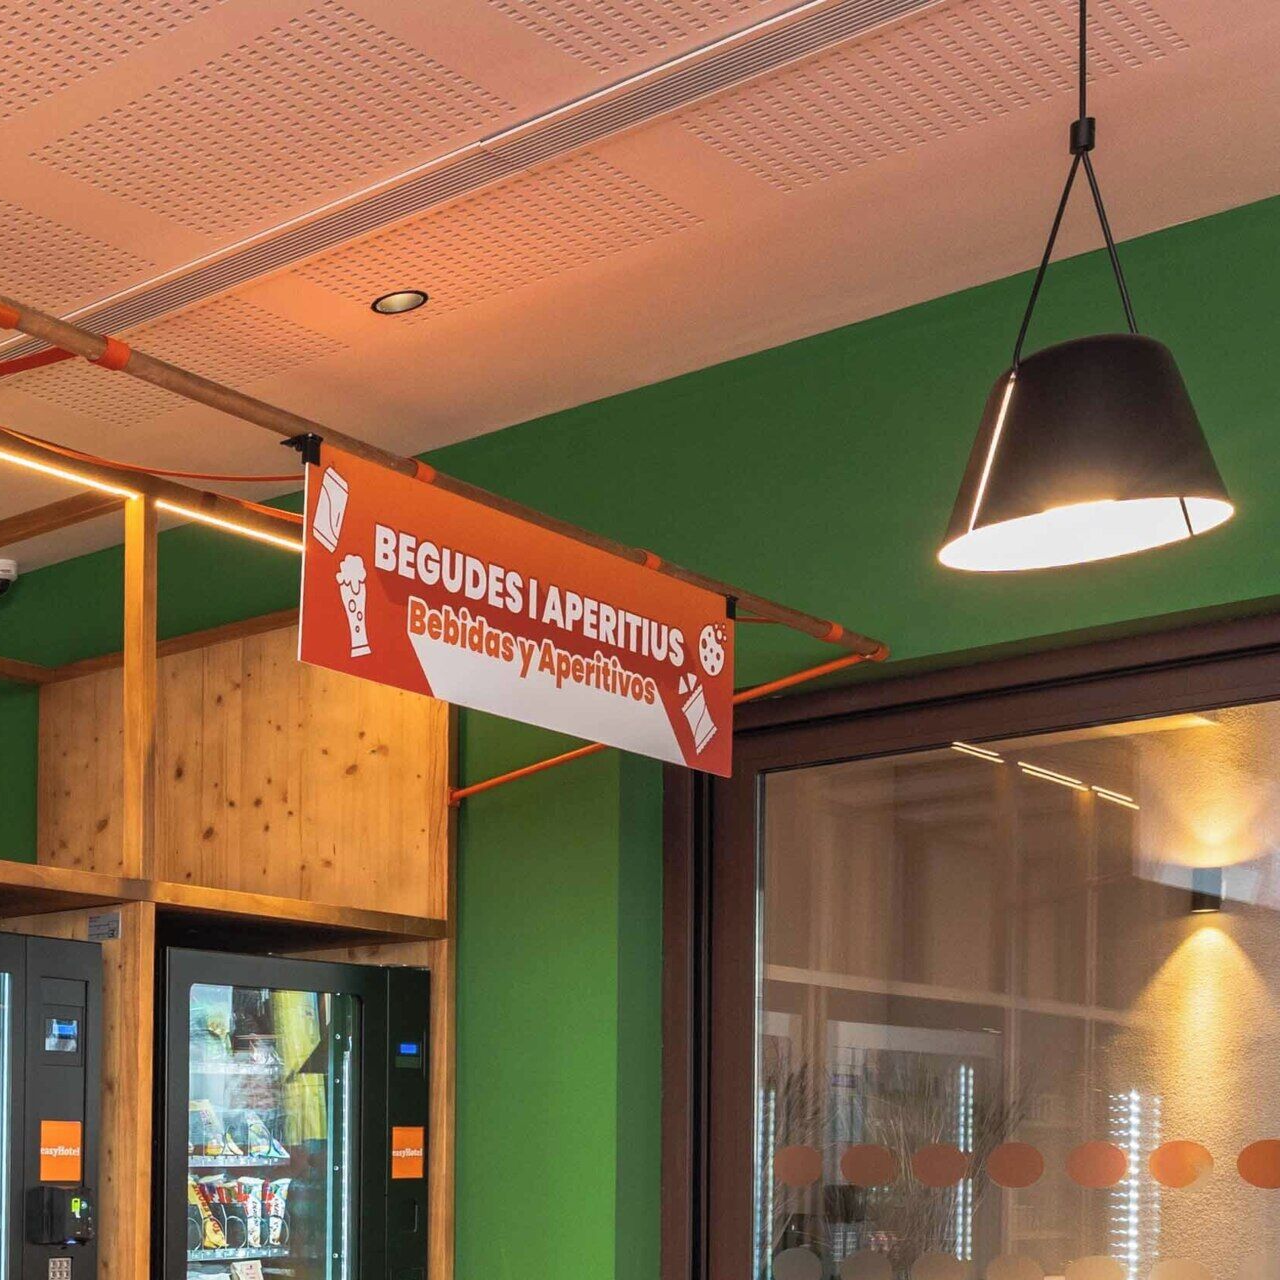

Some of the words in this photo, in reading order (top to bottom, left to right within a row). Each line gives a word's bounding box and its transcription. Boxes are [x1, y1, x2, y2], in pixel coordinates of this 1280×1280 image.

[375, 524, 523, 614] BEGUDES
[528, 578, 539, 621] I
[542, 585, 684, 667] APERITIUS
[408, 600, 515, 662] Bebidas
[519, 638, 537, 679] y
[539, 639, 656, 705] Aperitivos
[40, 1147, 80, 1157] easyHotel
